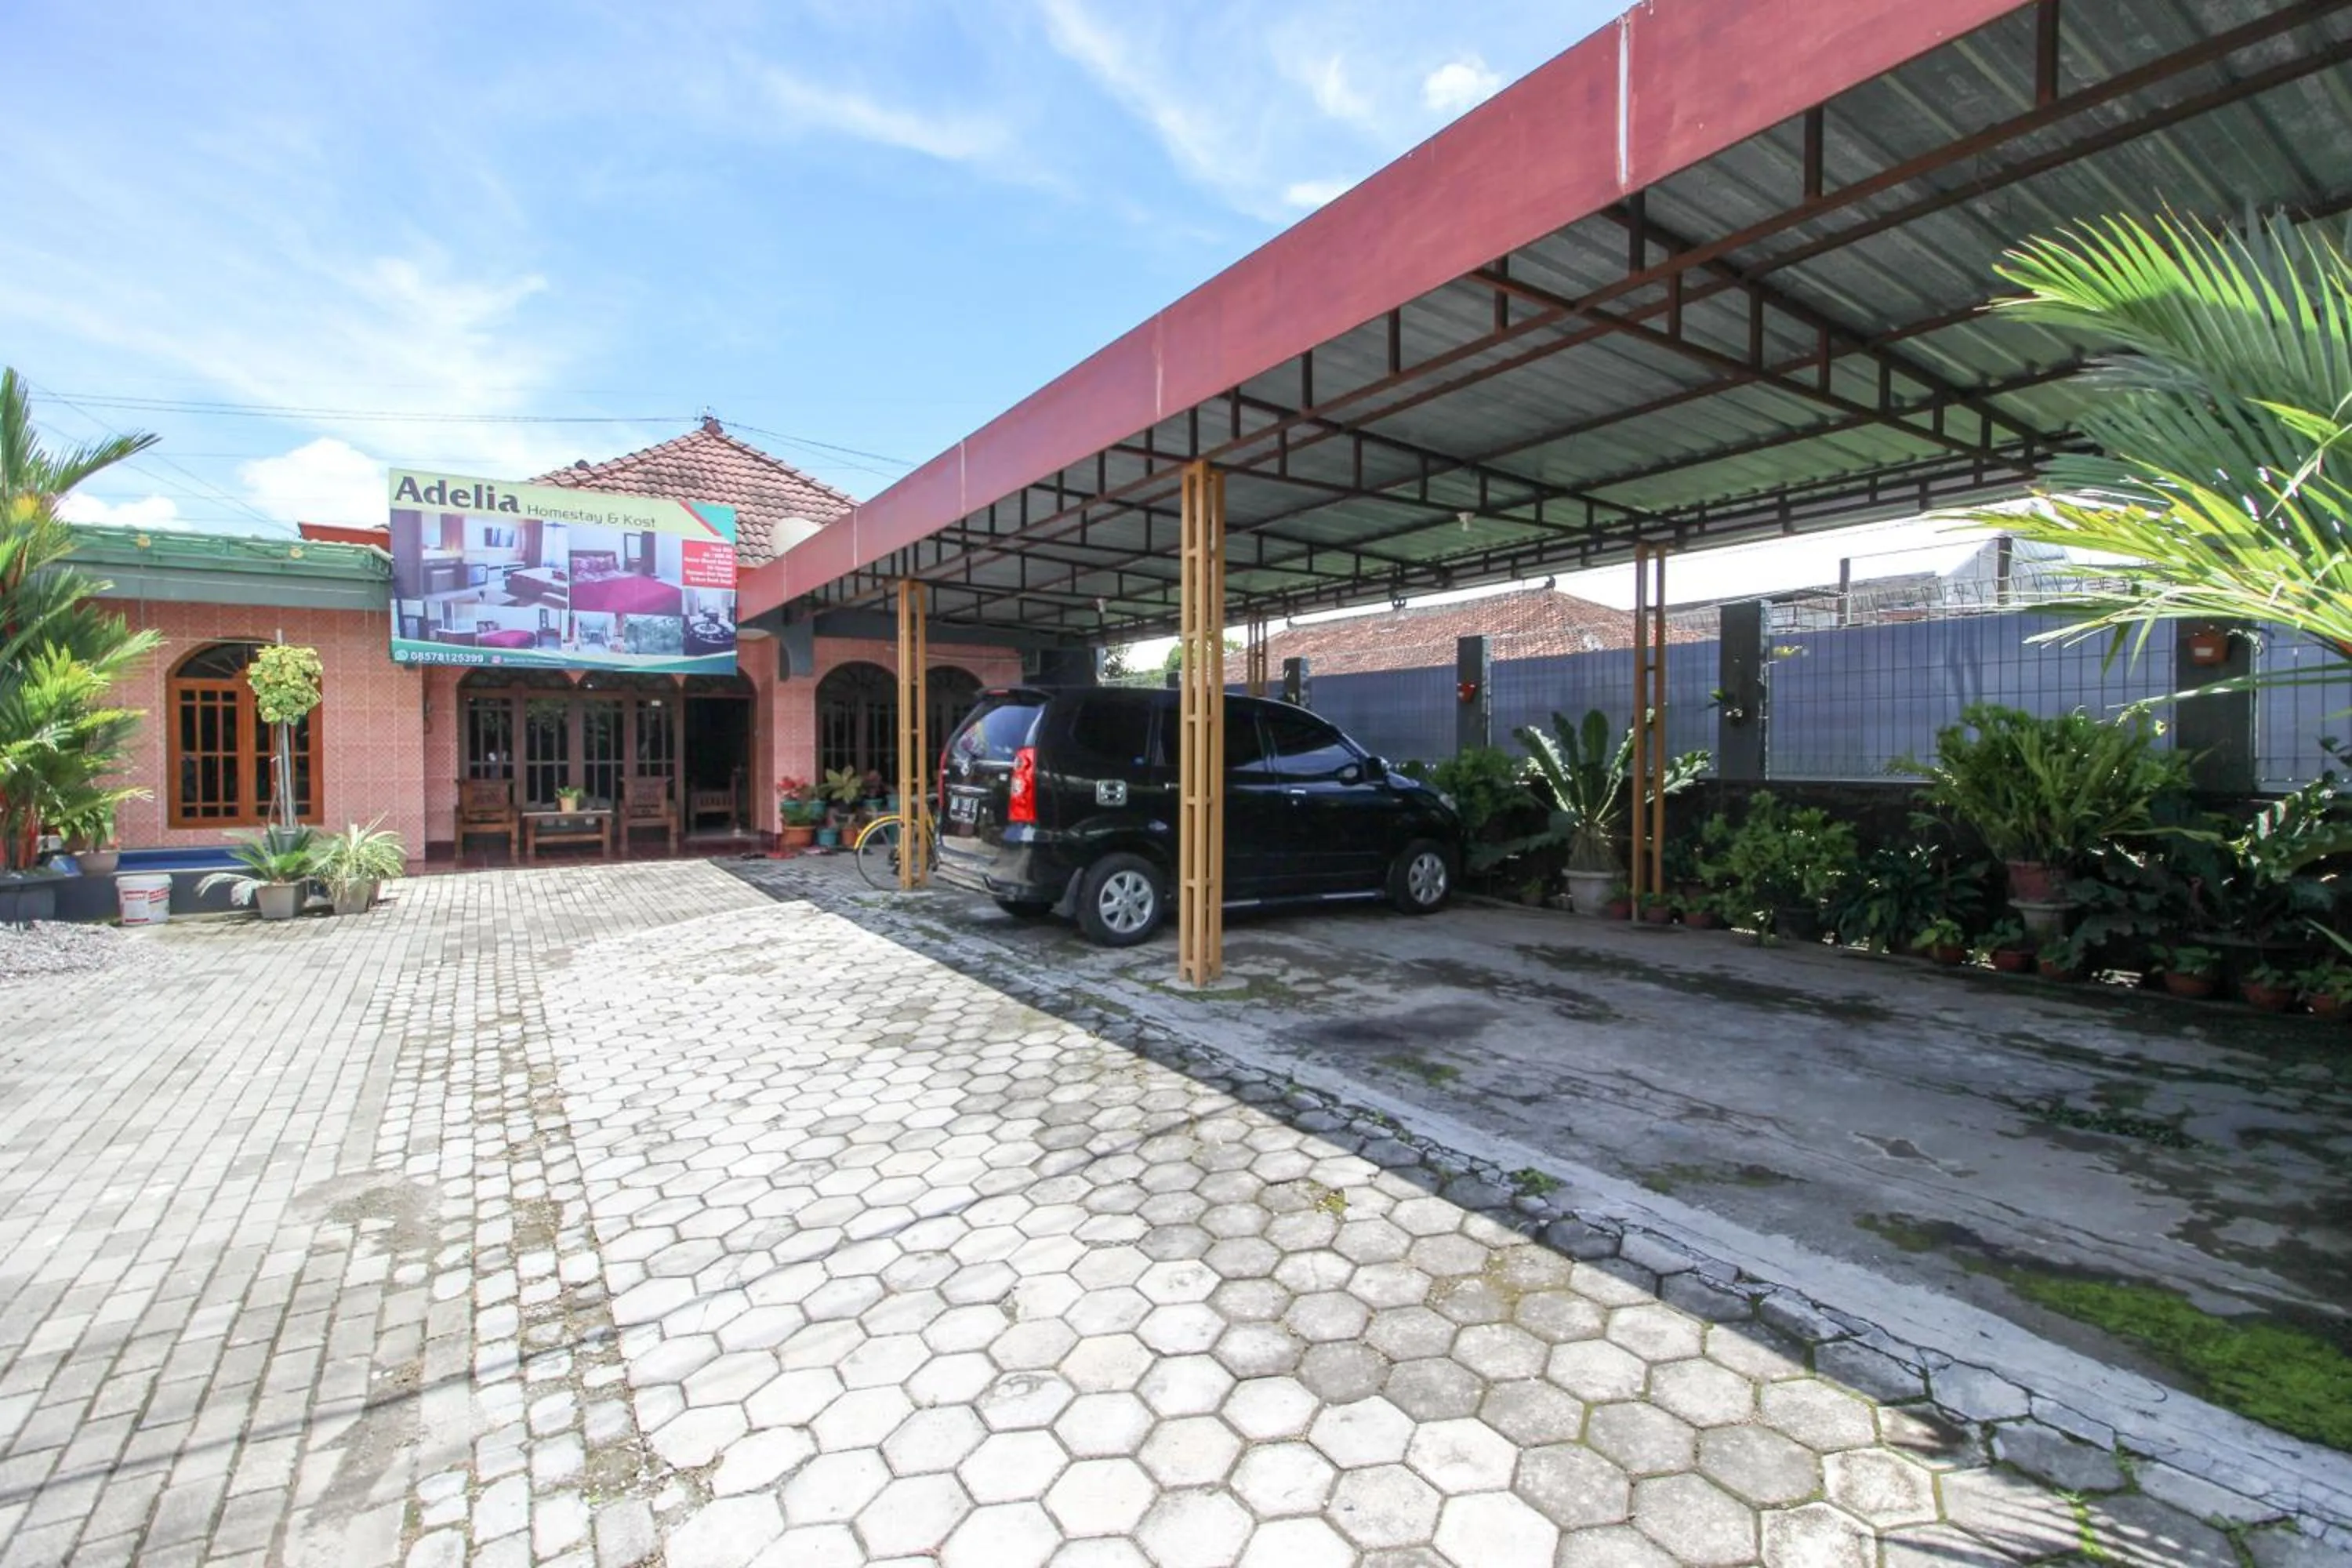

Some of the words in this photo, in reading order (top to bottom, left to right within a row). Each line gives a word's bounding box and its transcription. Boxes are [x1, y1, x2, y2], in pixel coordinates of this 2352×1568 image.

[394, 476, 521, 514] Adelia
[527, 504, 603, 524] Homestay
[607, 512, 619, 524] &
[623, 514, 656, 528] Kost
